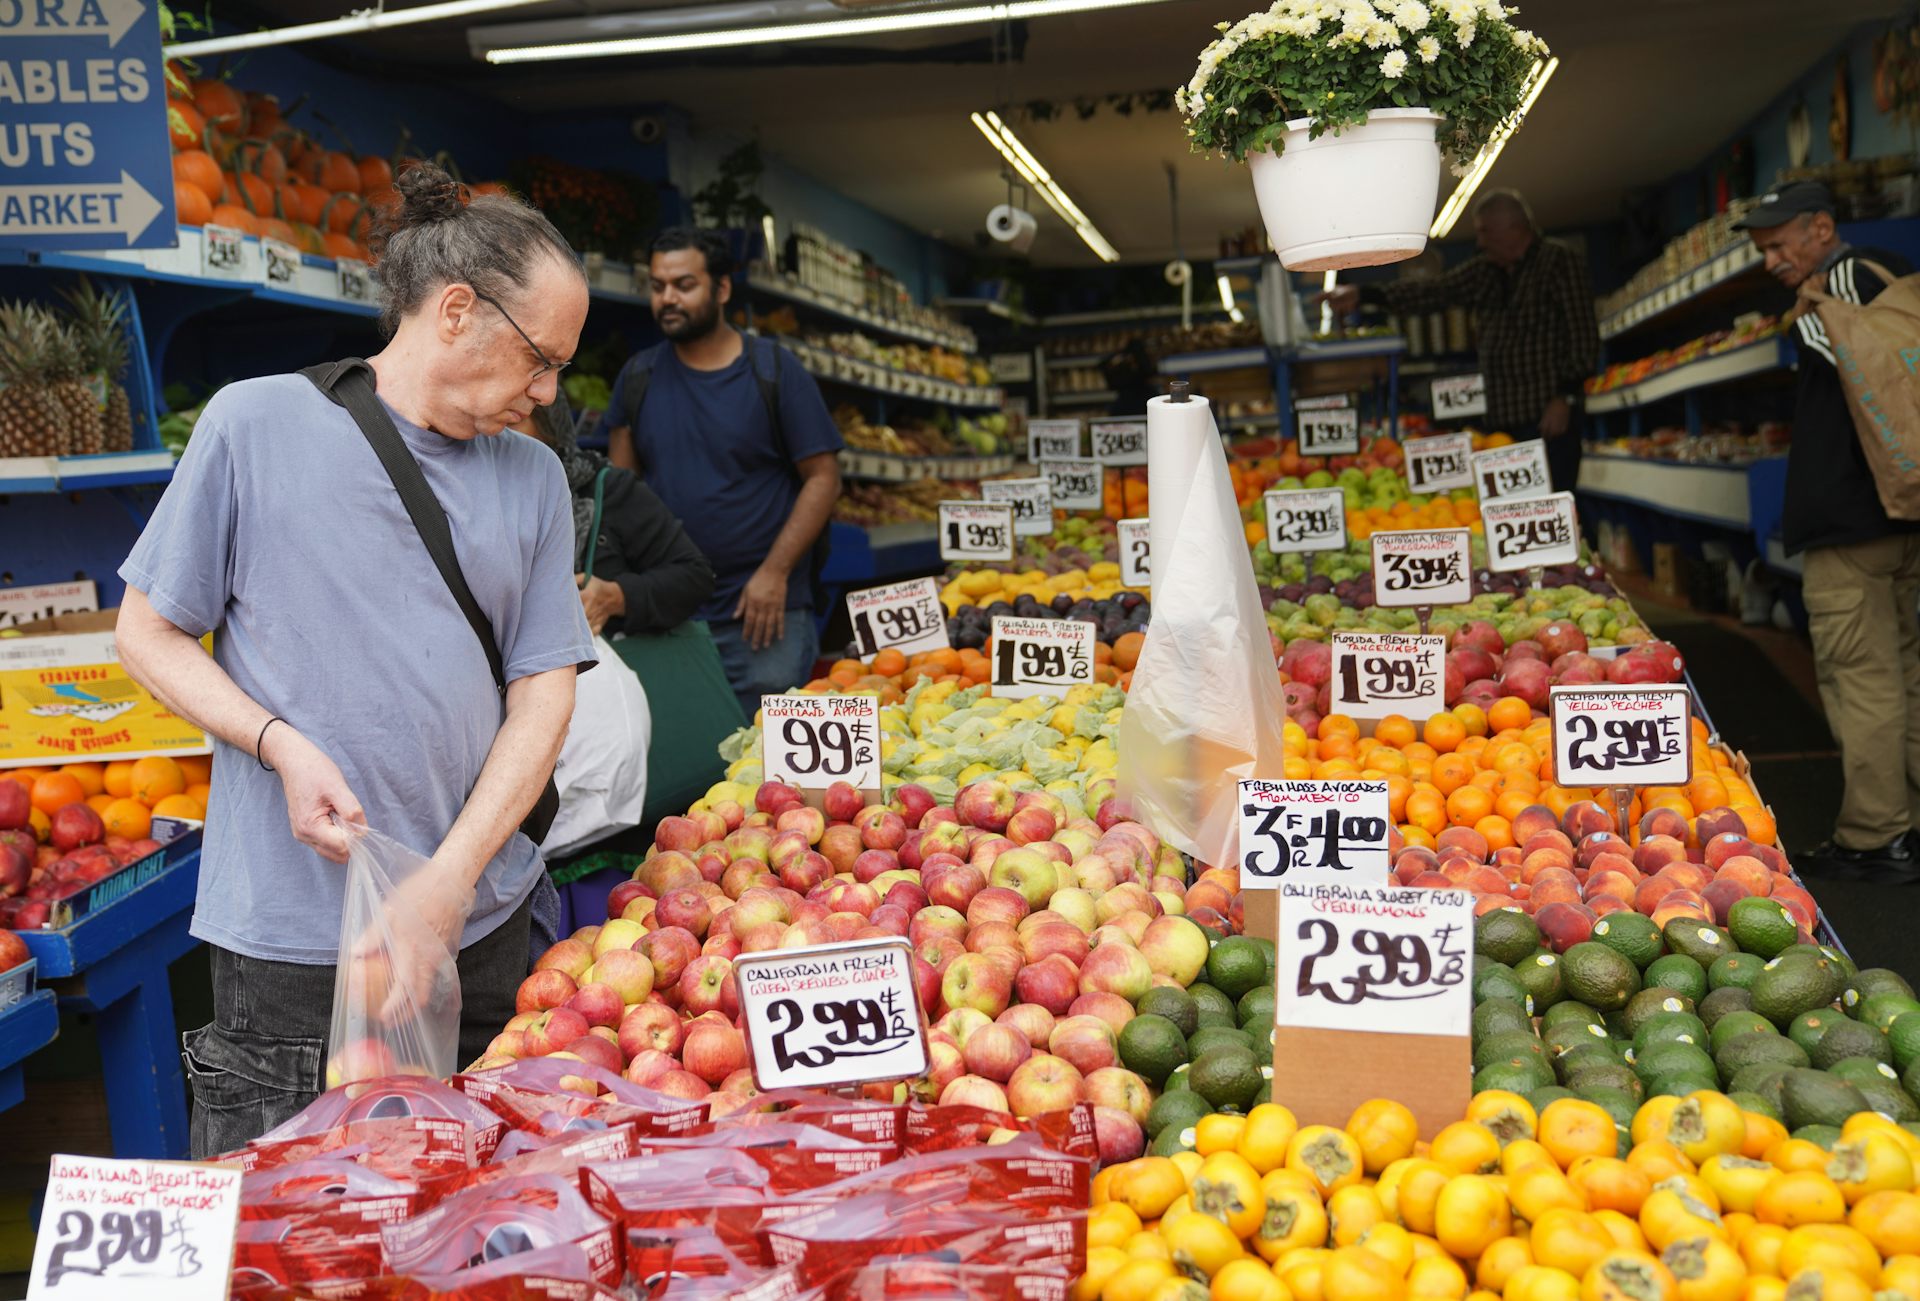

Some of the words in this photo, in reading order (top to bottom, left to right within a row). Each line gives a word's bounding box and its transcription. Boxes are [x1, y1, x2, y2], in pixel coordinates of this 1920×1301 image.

[2, 193, 122, 225] ARKET
[1304, 423, 1342, 447] 199
[1411, 453, 1455, 485] 199
[1483, 468, 1532, 498] 199
[947, 522, 998, 549] 199
[1276, 509, 1327, 542] 299
[1382, 553, 1447, 590] 399
[855, 605, 921, 656] 199
[1333, 634, 1376, 644] FLORIDA
[1380, 634, 1409, 645] FRESH
[1412, 636, 1443, 645] JUICY
[1347, 643, 1418, 653] TANGERINES
[39, 668, 108, 684] POTATOES
[992, 640, 1066, 686] 199
[1338, 654, 1416, 704] 199
[768, 708, 825, 717] CORTLAND
[833, 706, 873, 717] APPLES
[828, 697, 868, 709] FRESH
[1565, 701, 1608, 711] YELLOW
[1611, 701, 1663, 711] PEACHES
[37, 733, 77, 752] River
[81, 728, 132, 751] Samish
[783, 718, 853, 776] 99
[1565, 715, 1660, 770] 299
[1239, 780, 1284, 792] FRESH
[1286, 782, 1317, 793] HASS
[1322, 781, 1387, 793] AVOCADOS
[1298, 793, 1360, 803] MEXICO
[1243, 804, 1290, 877] 3
[1282, 884, 1373, 902] CALIFORNIA
[1376, 888, 1428, 904] SWEET
[747, 963, 840, 982] CALIFORNIA
[843, 953, 894, 971] FRESH
[1297, 919, 1432, 1005] 299
[766, 998, 888, 1073] 299
[55, 1183, 96, 1203] BABY
[45, 1209, 162, 1287] 299
